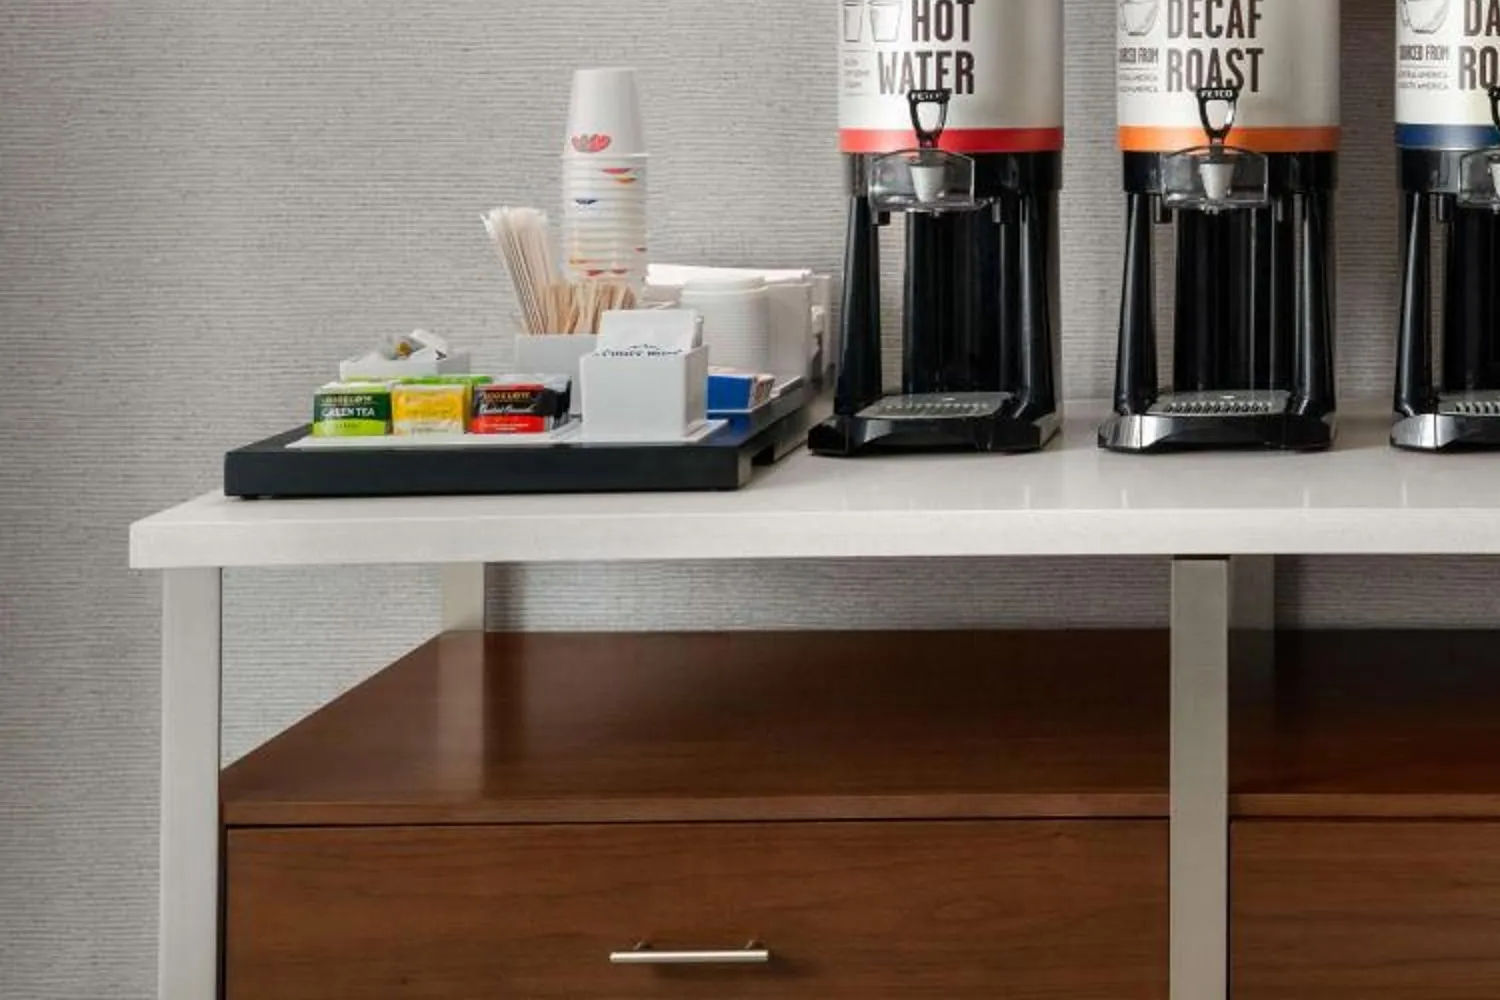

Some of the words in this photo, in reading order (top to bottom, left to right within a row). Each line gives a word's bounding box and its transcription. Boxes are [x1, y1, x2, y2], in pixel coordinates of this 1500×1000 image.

[1425, 45, 1449, 61] FROM
[877, 50, 976, 95] WATER
[1166, 47, 1265, 92] ROAST
[320, 407, 355, 417] GREEN
[356, 407, 376, 417] TEA
